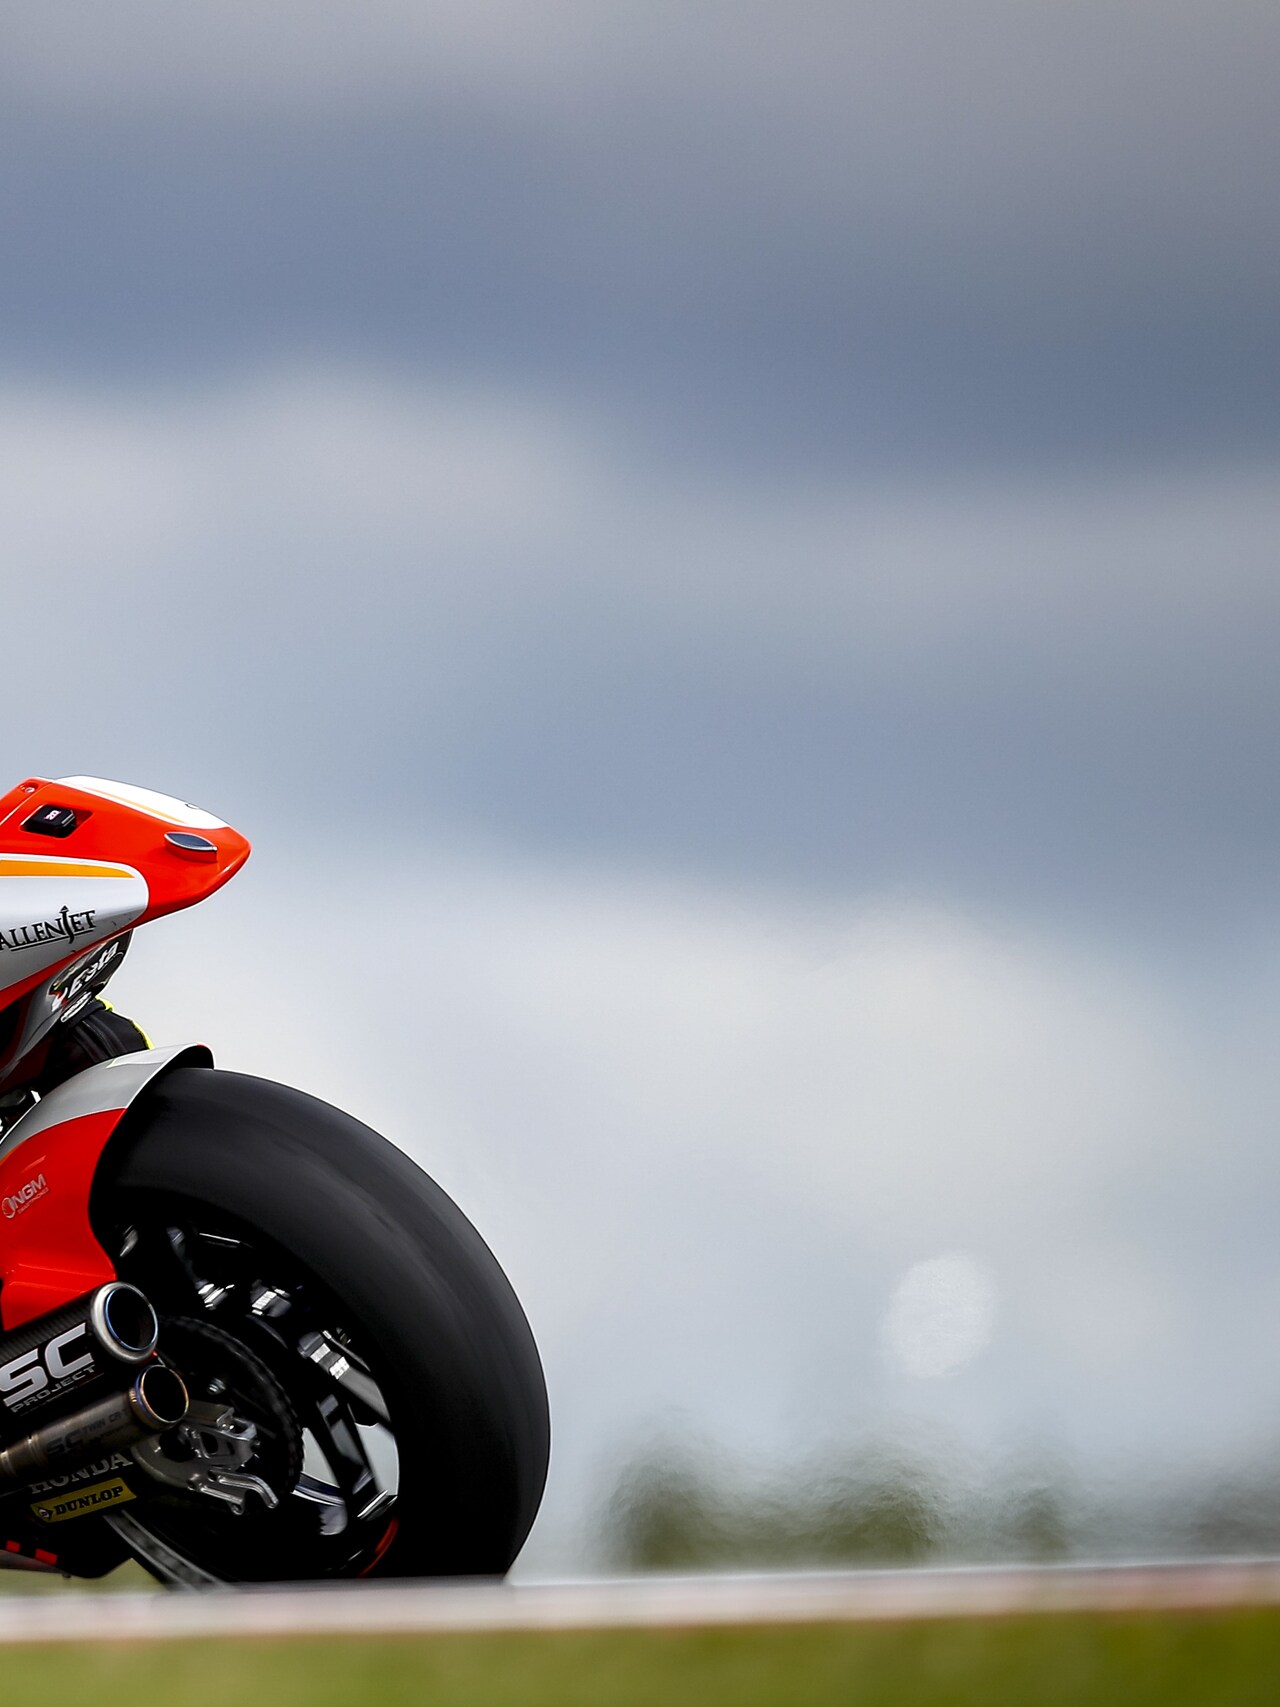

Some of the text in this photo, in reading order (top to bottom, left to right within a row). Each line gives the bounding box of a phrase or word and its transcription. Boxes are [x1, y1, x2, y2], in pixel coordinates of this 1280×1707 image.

[12, 1173, 47, 1208] NGM
[10, 1364, 97, 1414] PROJECT
[54, 1486, 123, 1515] DUNLOP
